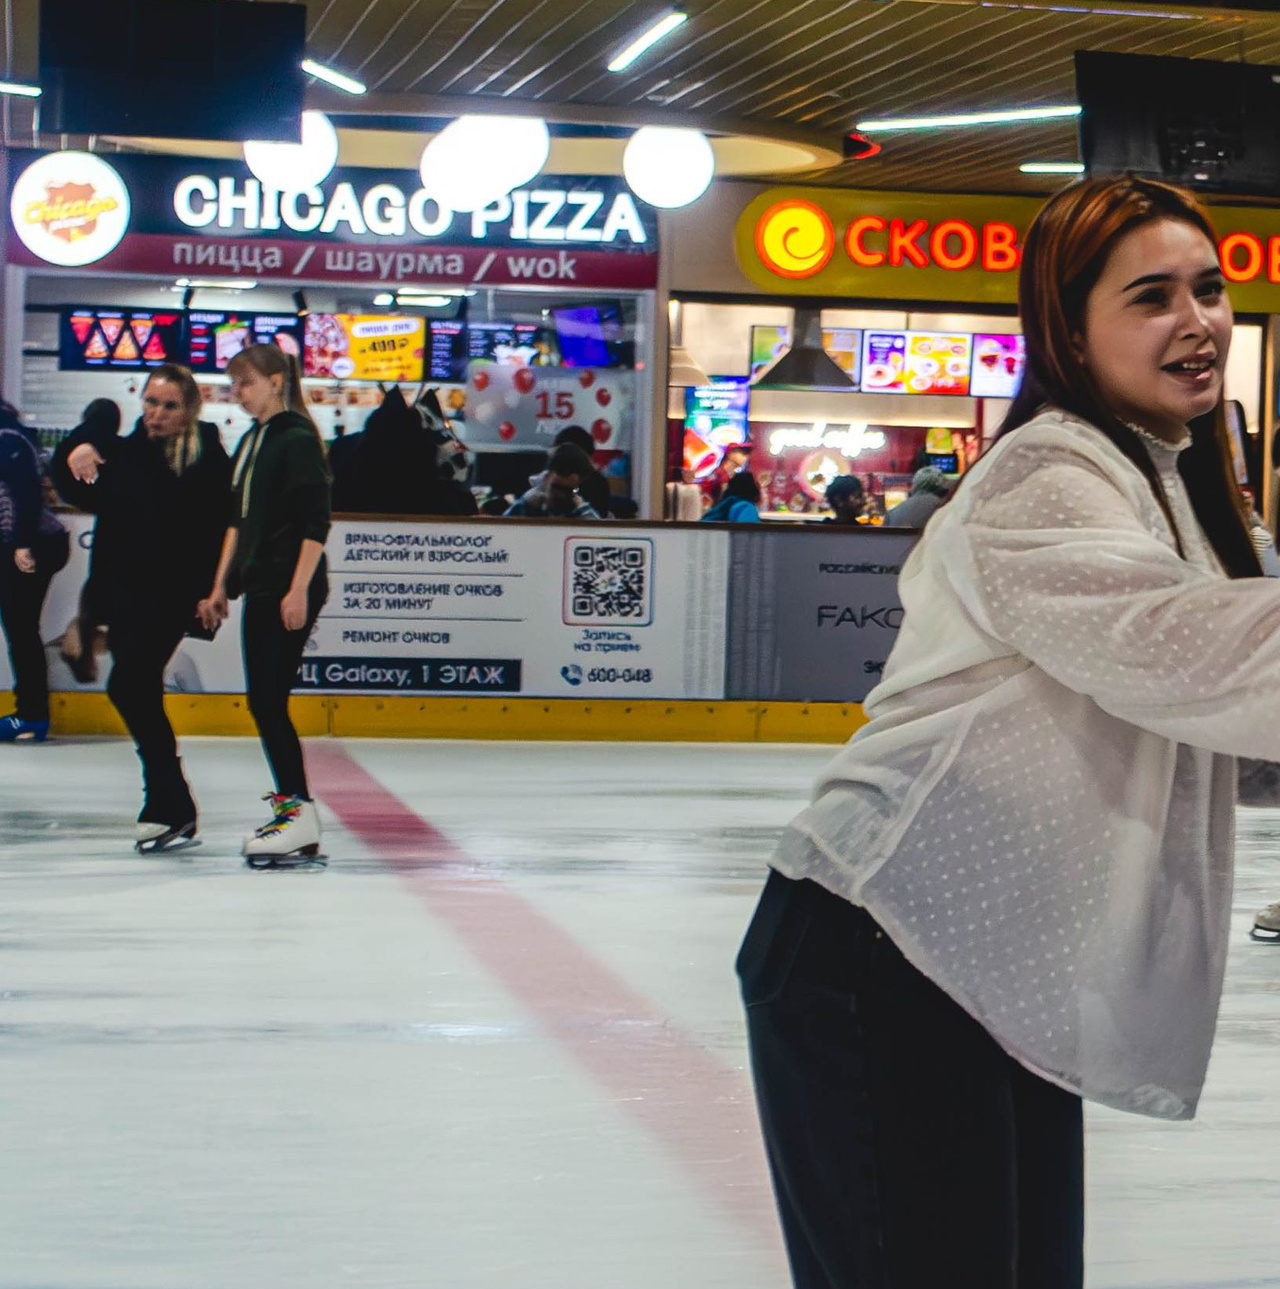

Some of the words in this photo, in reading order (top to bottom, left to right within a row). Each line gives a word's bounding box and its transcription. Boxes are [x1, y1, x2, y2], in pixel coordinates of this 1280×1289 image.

[173, 175, 453, 237] CHICAGO
[470, 189, 648, 244] PIZZA
[173, 243, 282, 273] пицца
[325, 249, 465, 280] шаурма
[507, 250, 577, 280] wok
[535, 391, 575, 419] 15
[344, 548, 410, 562] ДЕТСКИЙ
[414, 550, 425, 562] И
[428, 550, 509, 563] ВЗРОСЛЫЙ
[344, 582, 451, 597] ИЗГОТОВЛЕНИЕ
[454, 583, 504, 597] ОЧКОВ
[343, 598, 362, 610] ЗА
[365, 598, 382, 610] 20
[385, 597, 434, 611] МИНУТ
[343, 630, 400, 644] РЕМОНТ
[402, 631, 450, 645] ОЧКОВ
[297, 663, 321, 685] Ц
[325, 663, 412, 687] Galaxy,
[422, 664, 430, 684] 1
[439, 665, 505, 686] ЭТАЖ
